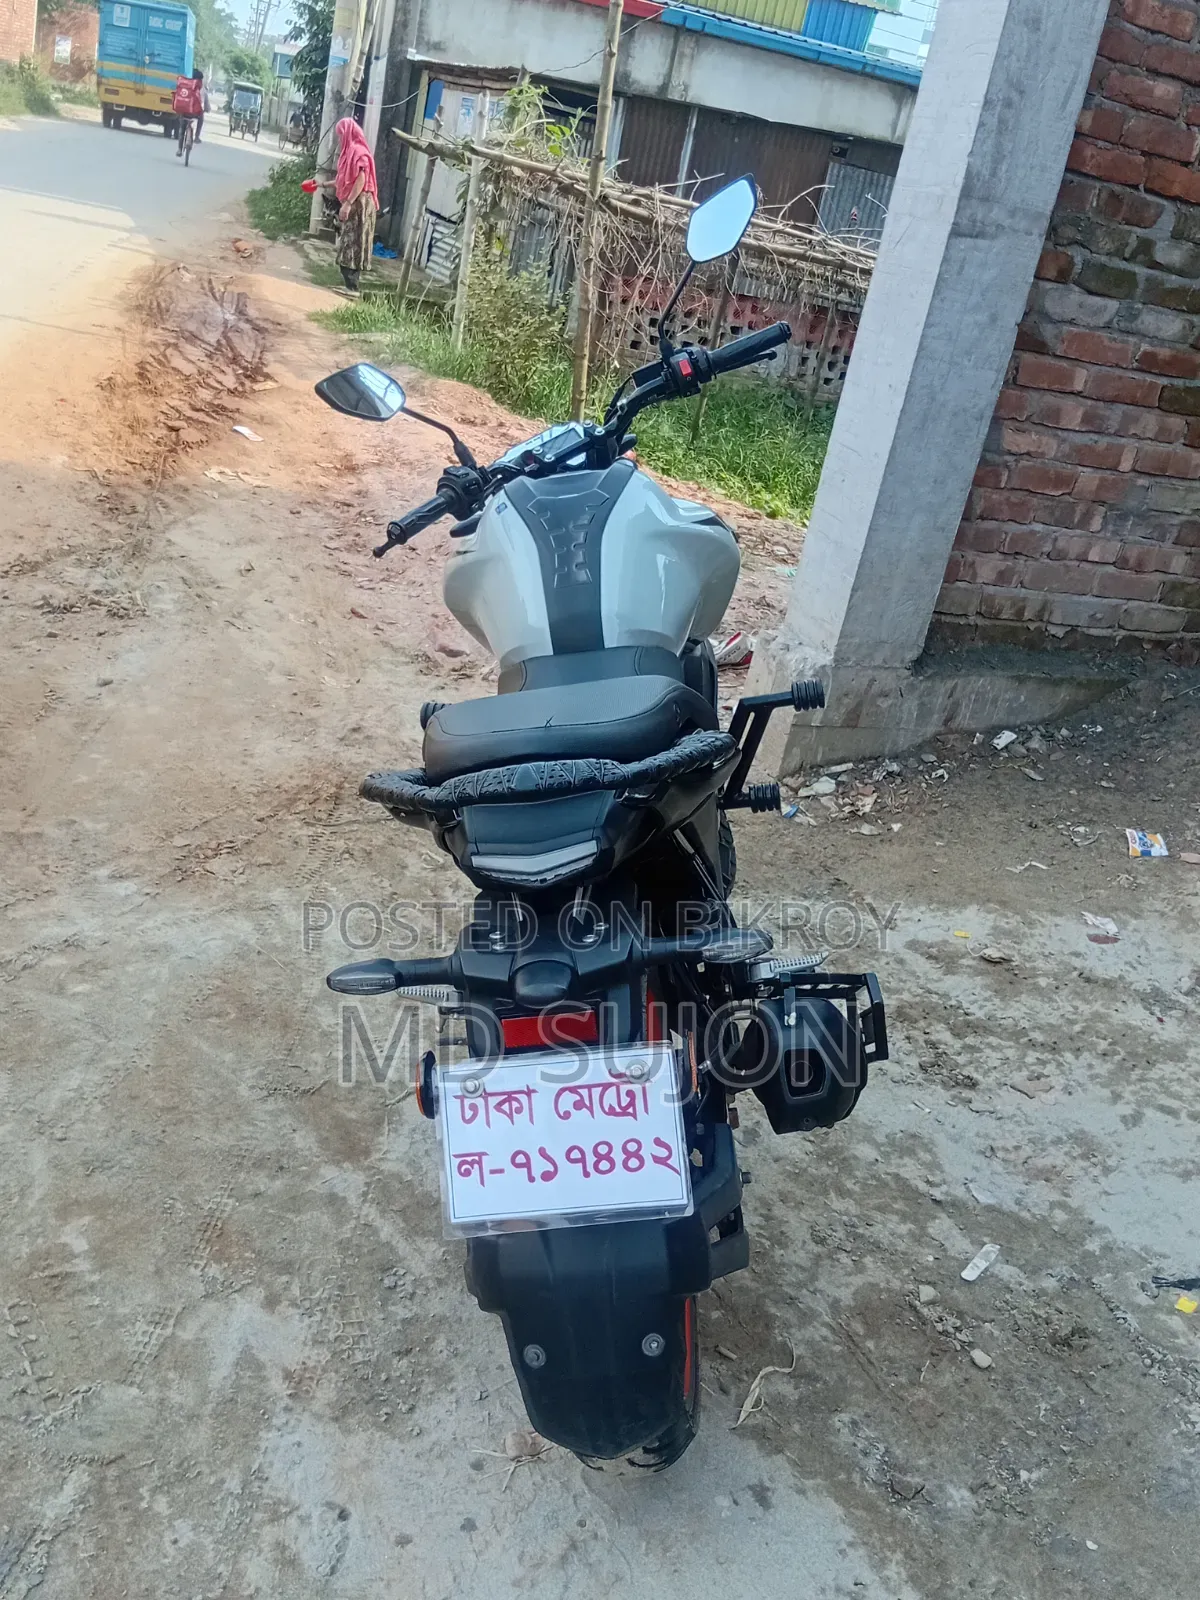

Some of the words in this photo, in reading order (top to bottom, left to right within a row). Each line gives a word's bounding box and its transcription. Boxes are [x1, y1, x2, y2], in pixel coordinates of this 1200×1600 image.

[453, 1083, 538, 1129] ঢাকা
[553, 1068, 650, 1122] মেট্রো
[452, 1136, 681, 1188] ল-৭১৭৪৪২
